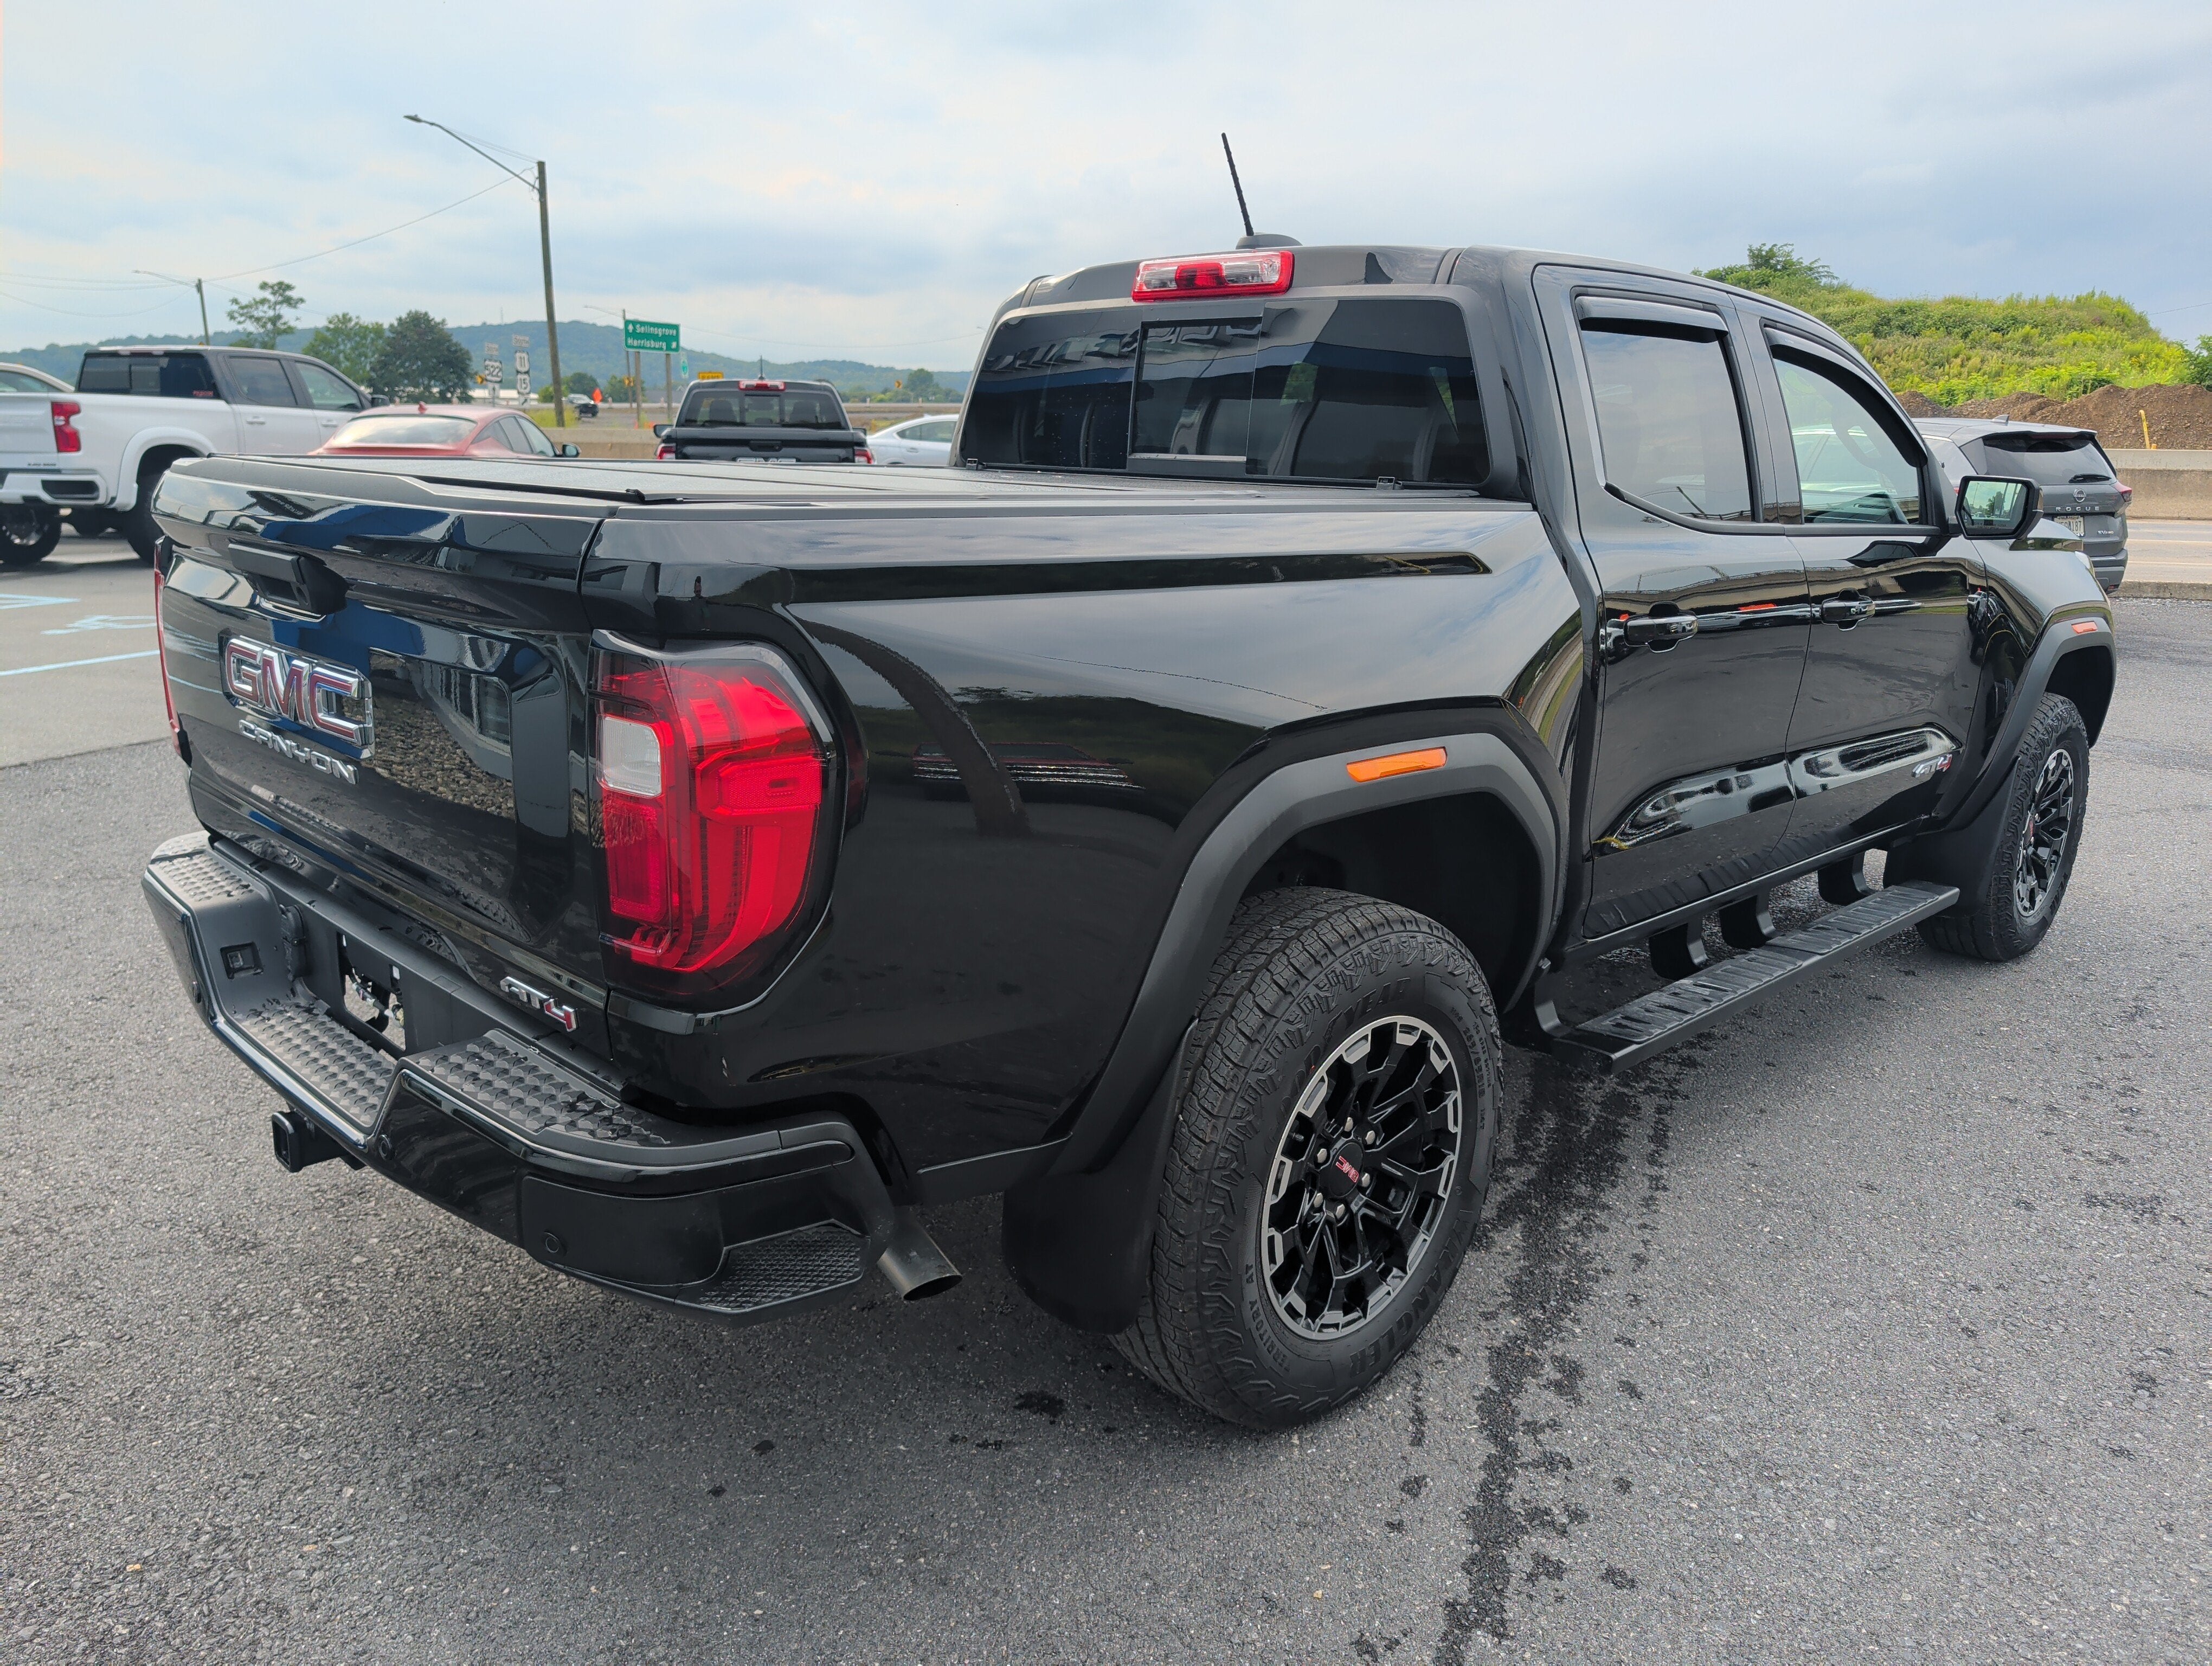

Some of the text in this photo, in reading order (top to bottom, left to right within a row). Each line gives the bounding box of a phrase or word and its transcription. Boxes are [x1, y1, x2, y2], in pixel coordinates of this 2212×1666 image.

[627, 337, 666, 350] Harrisburg
[635, 324, 677, 337] Selinsgrove
[519, 378, 529, 390] 15
[225, 638, 363, 746] GMC
[239, 719, 359, 785] CANYON
[1912, 753, 1953, 778] AT4
[500, 976, 578, 1032] AT4
[1335, 1155, 1360, 1183] GMC
[1349, 1209, 1474, 1377] WRANGLER
[1249, 1298, 1290, 1373] TERRITORY
